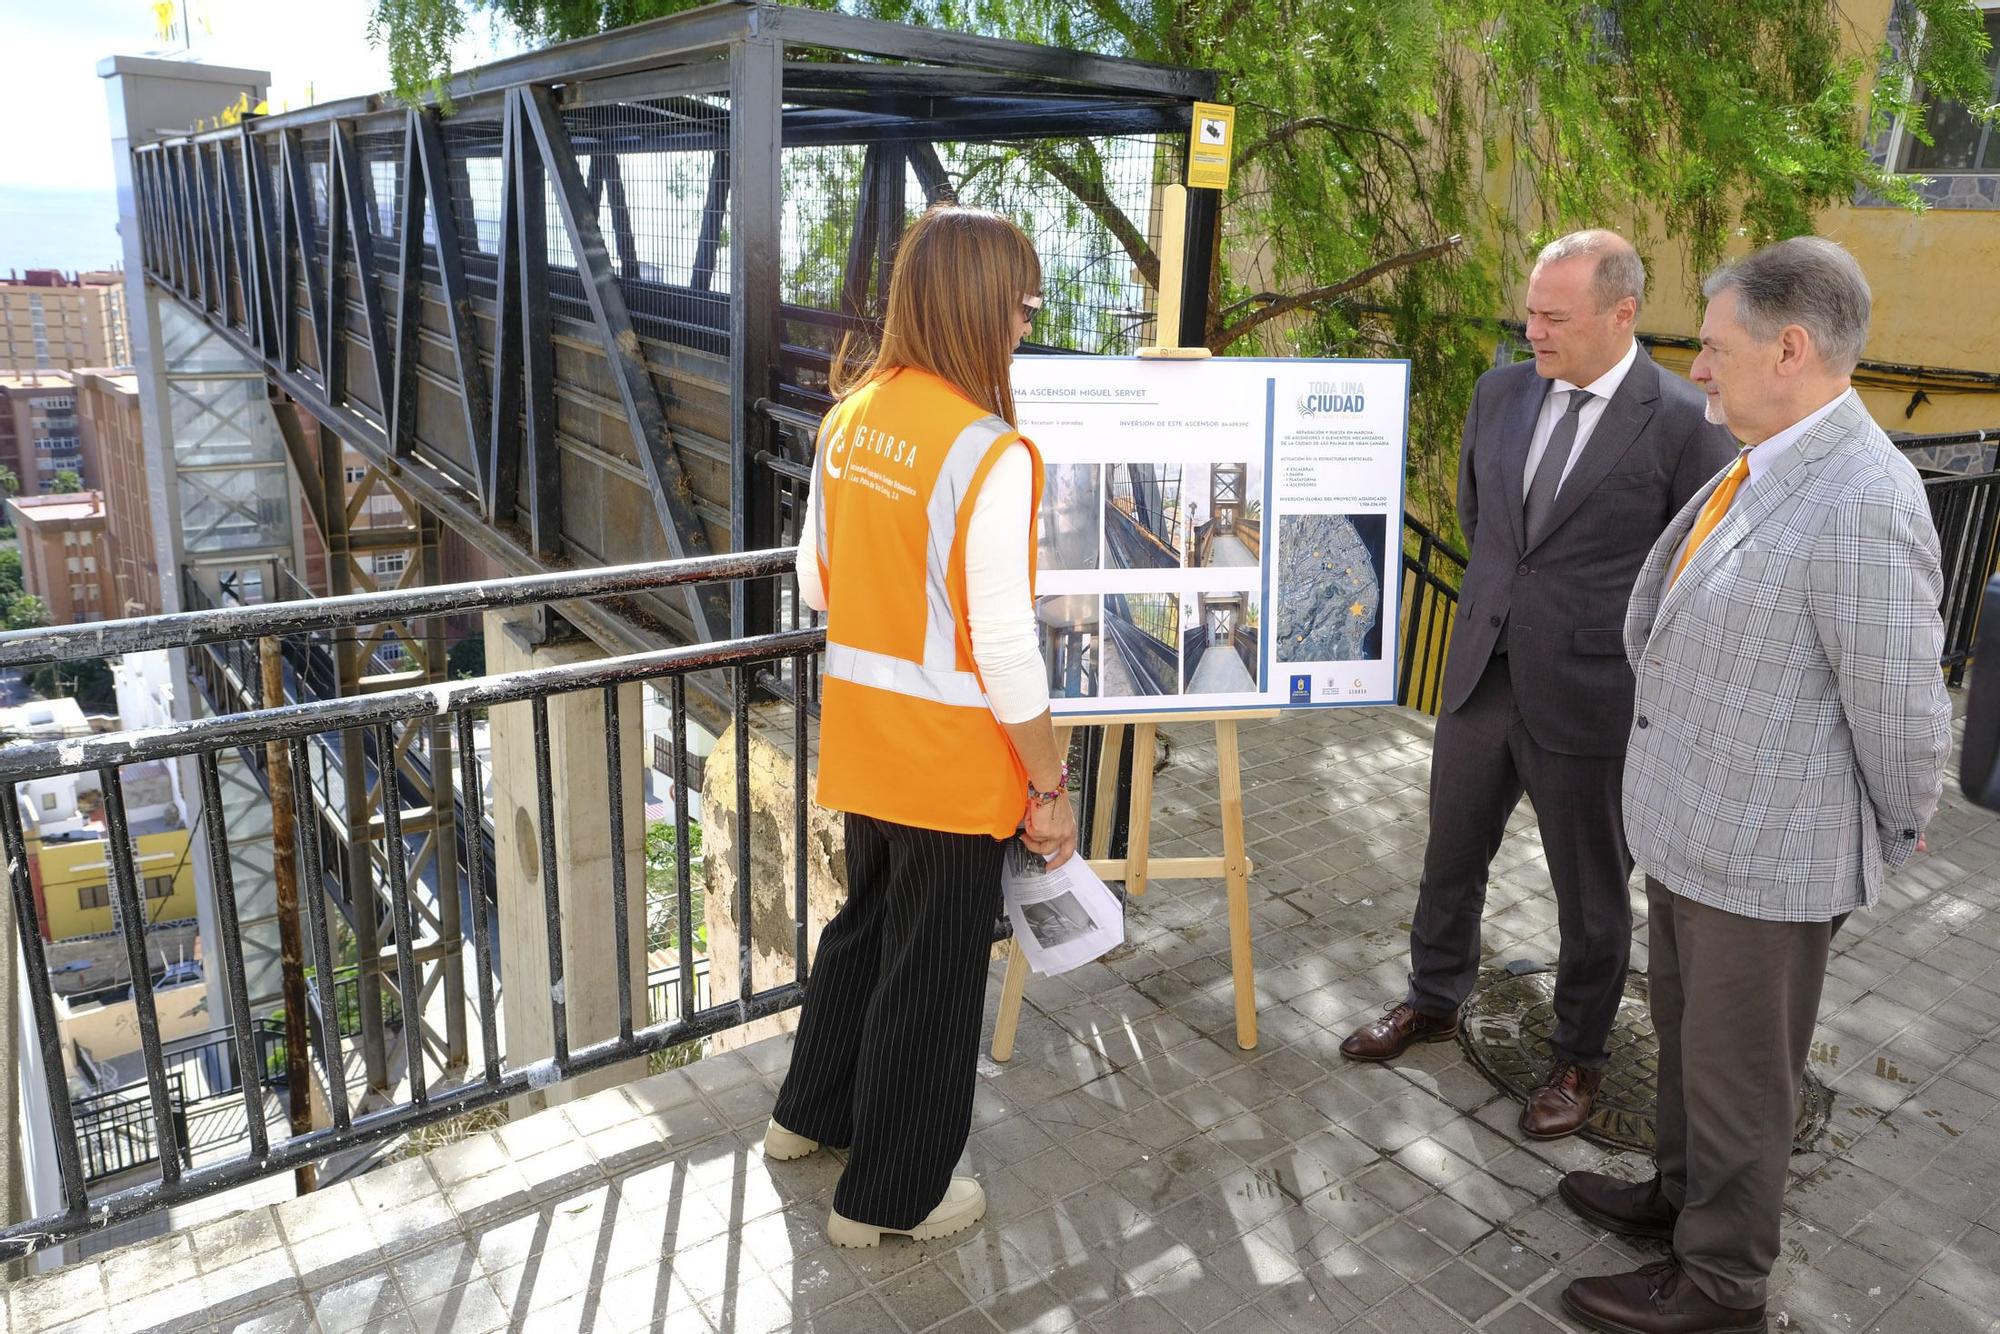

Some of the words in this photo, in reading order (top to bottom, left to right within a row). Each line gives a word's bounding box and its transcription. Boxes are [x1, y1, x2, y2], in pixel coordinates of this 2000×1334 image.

[1030, 388, 1076, 397] ASCENSOR
[1079, 388, 1112, 397] MIGUEL
[1115, 388, 1147, 398] SERVET
[1308, 381, 1337, 394] TODA
[1342, 381, 1365, 394] UNA
[1308, 395, 1365, 412] CIUDAD
[1120, 419, 1155, 427] INVERSIÓN
[855, 425, 917, 468] GEURSA
